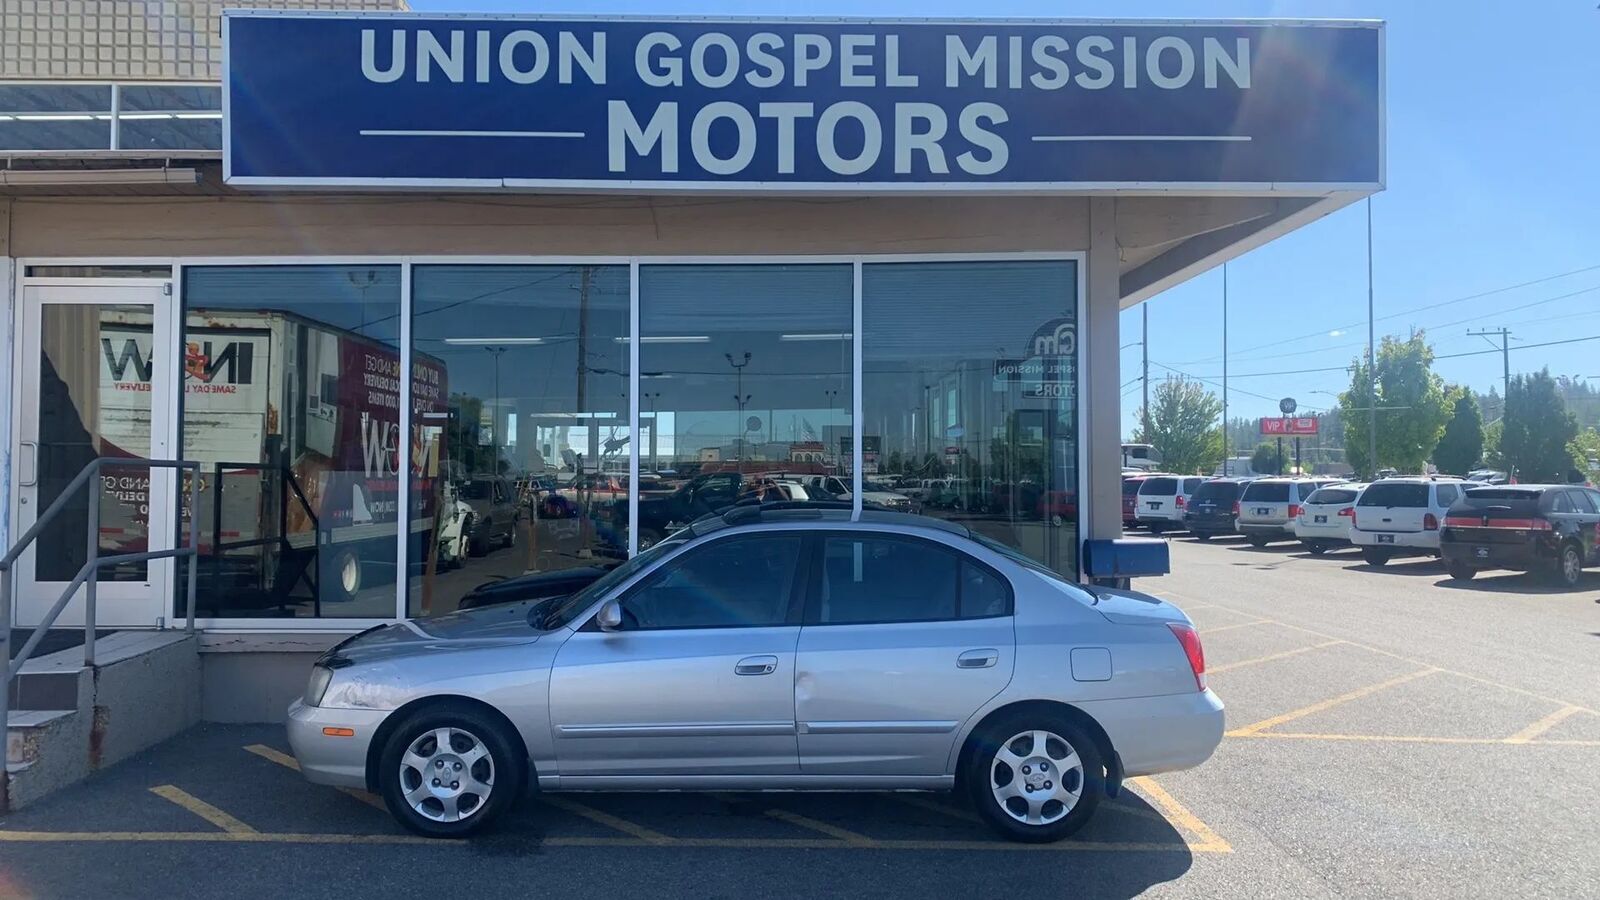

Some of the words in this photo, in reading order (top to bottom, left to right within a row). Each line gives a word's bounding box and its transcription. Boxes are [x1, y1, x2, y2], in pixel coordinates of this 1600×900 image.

[361, 29, 607, 86] UNION
[635, 32, 919, 89] GOSPEL
[945, 34, 1251, 90] MISSION
[607, 100, 1009, 176] MOTORS
[1266, 421, 1281, 431] VIP
